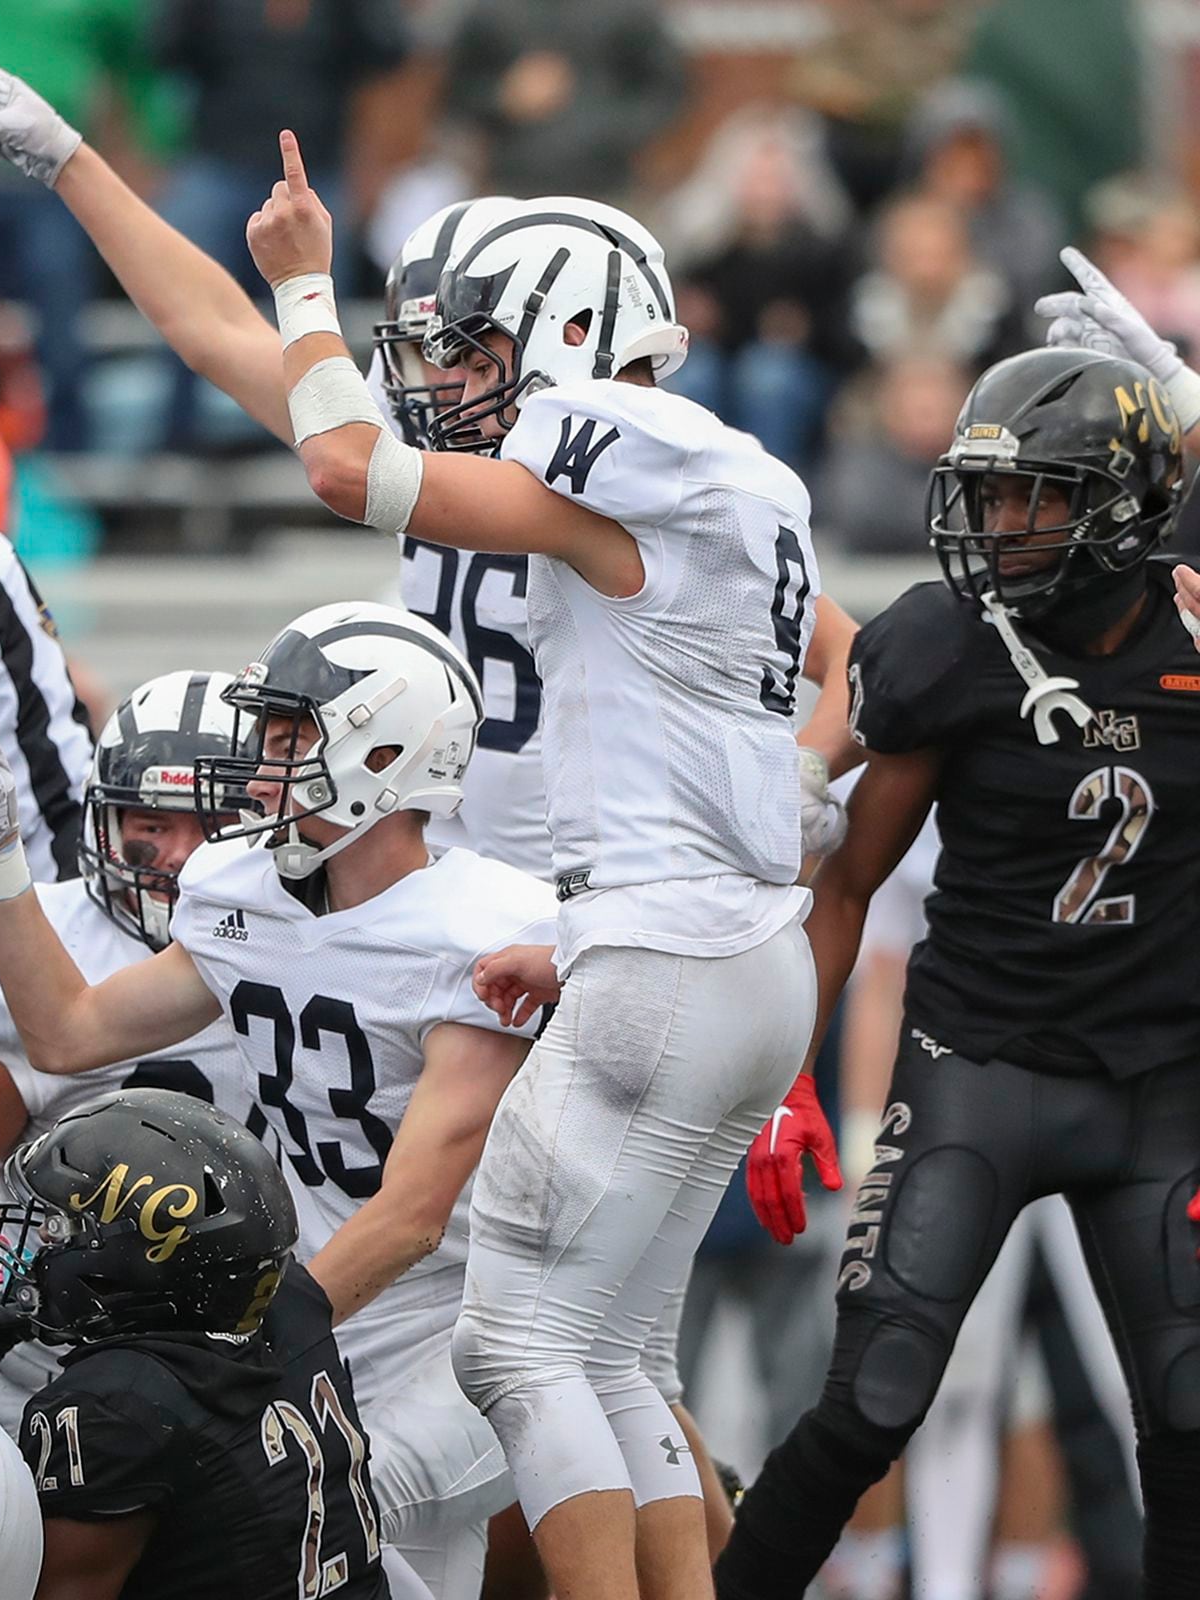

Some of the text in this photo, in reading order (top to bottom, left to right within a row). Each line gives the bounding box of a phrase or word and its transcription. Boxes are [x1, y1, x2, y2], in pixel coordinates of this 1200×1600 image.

[758, 524, 811, 717] 9
[1082, 708, 1141, 753] NG
[1052, 765, 1156, 926] 2
[212, 926, 249, 942] adidas
[229, 978, 396, 1199] 33
[70, 1162, 199, 1264] NG
[30, 1405, 86, 1492] 21
[260, 1369, 381, 1600] 21
